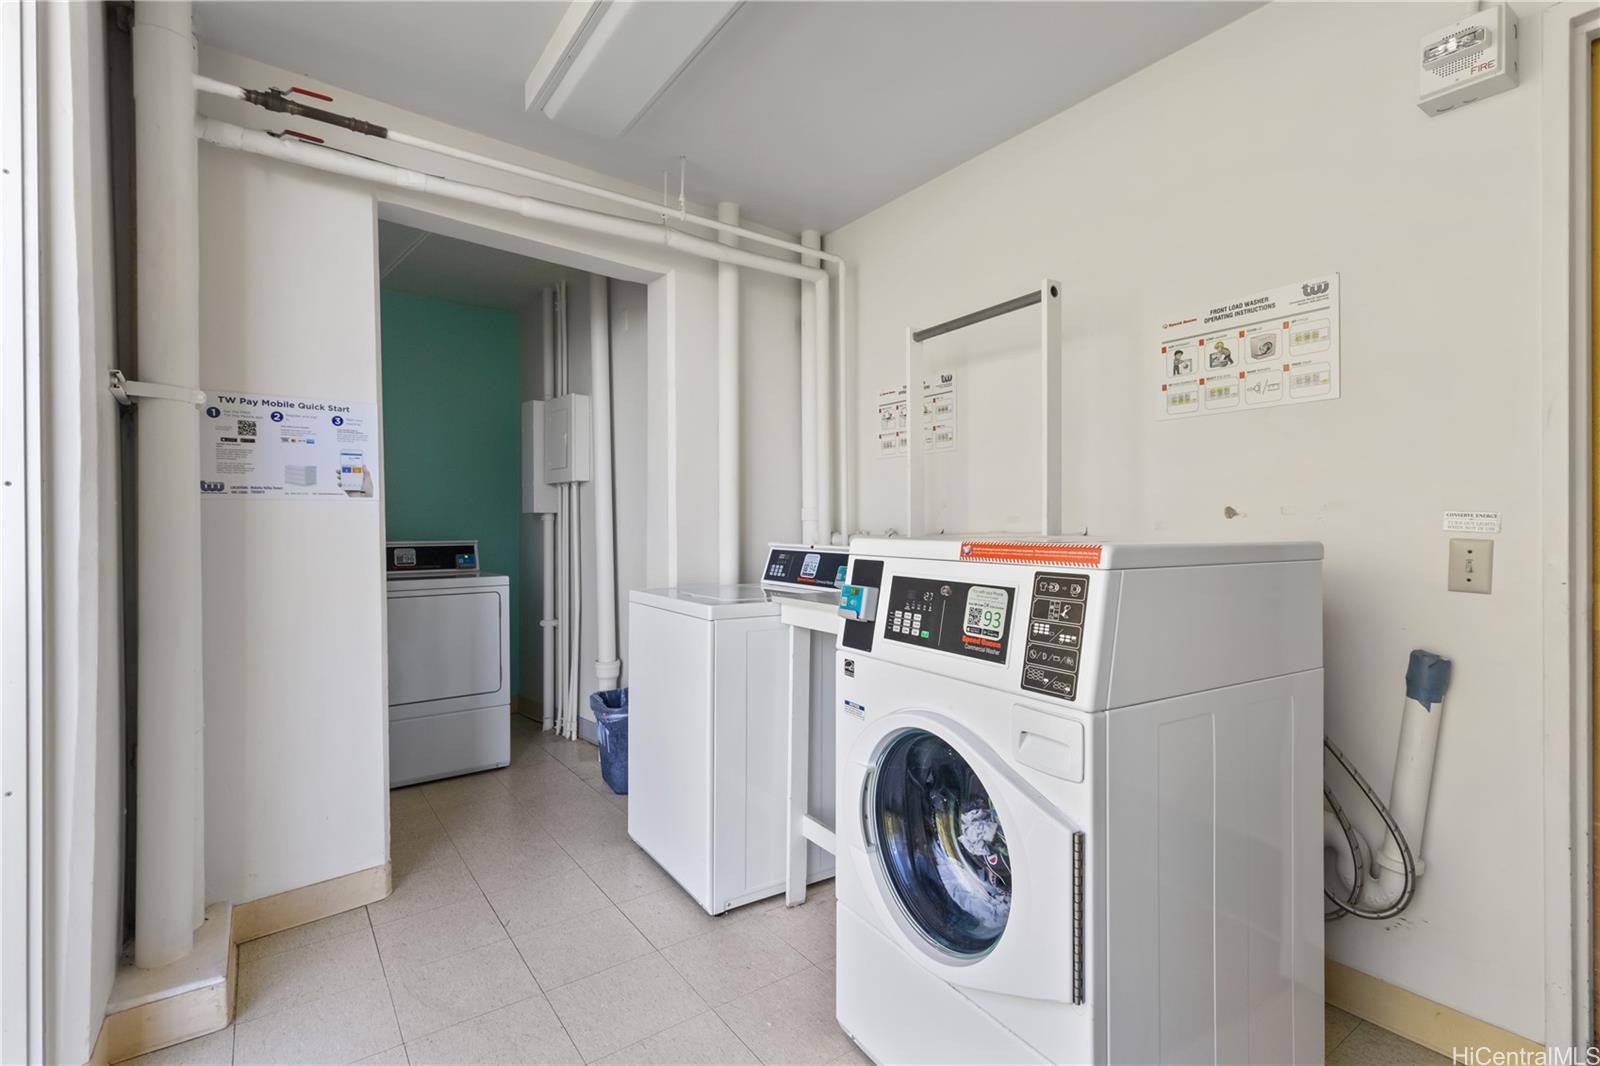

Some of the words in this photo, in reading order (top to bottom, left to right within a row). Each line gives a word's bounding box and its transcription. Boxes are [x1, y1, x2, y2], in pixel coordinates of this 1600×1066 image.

[1470, 59, 1496, 75] FIRE
[1203, 312, 1233, 324] OPERATING
[1234, 303, 1276, 318] INSTRUCTIONS
[1209, 306, 1227, 316] FRONT
[1227, 302, 1244, 312] LOAD
[1244, 296, 1269, 308] WASHER
[218, 396, 236, 404] TW
[240, 397, 258, 407] Pay
[261, 399, 295, 409] Mobile
[298, 402, 325, 412] Quick
[328, 405, 350, 413] Start
[983, 610, 1002, 629] 93
